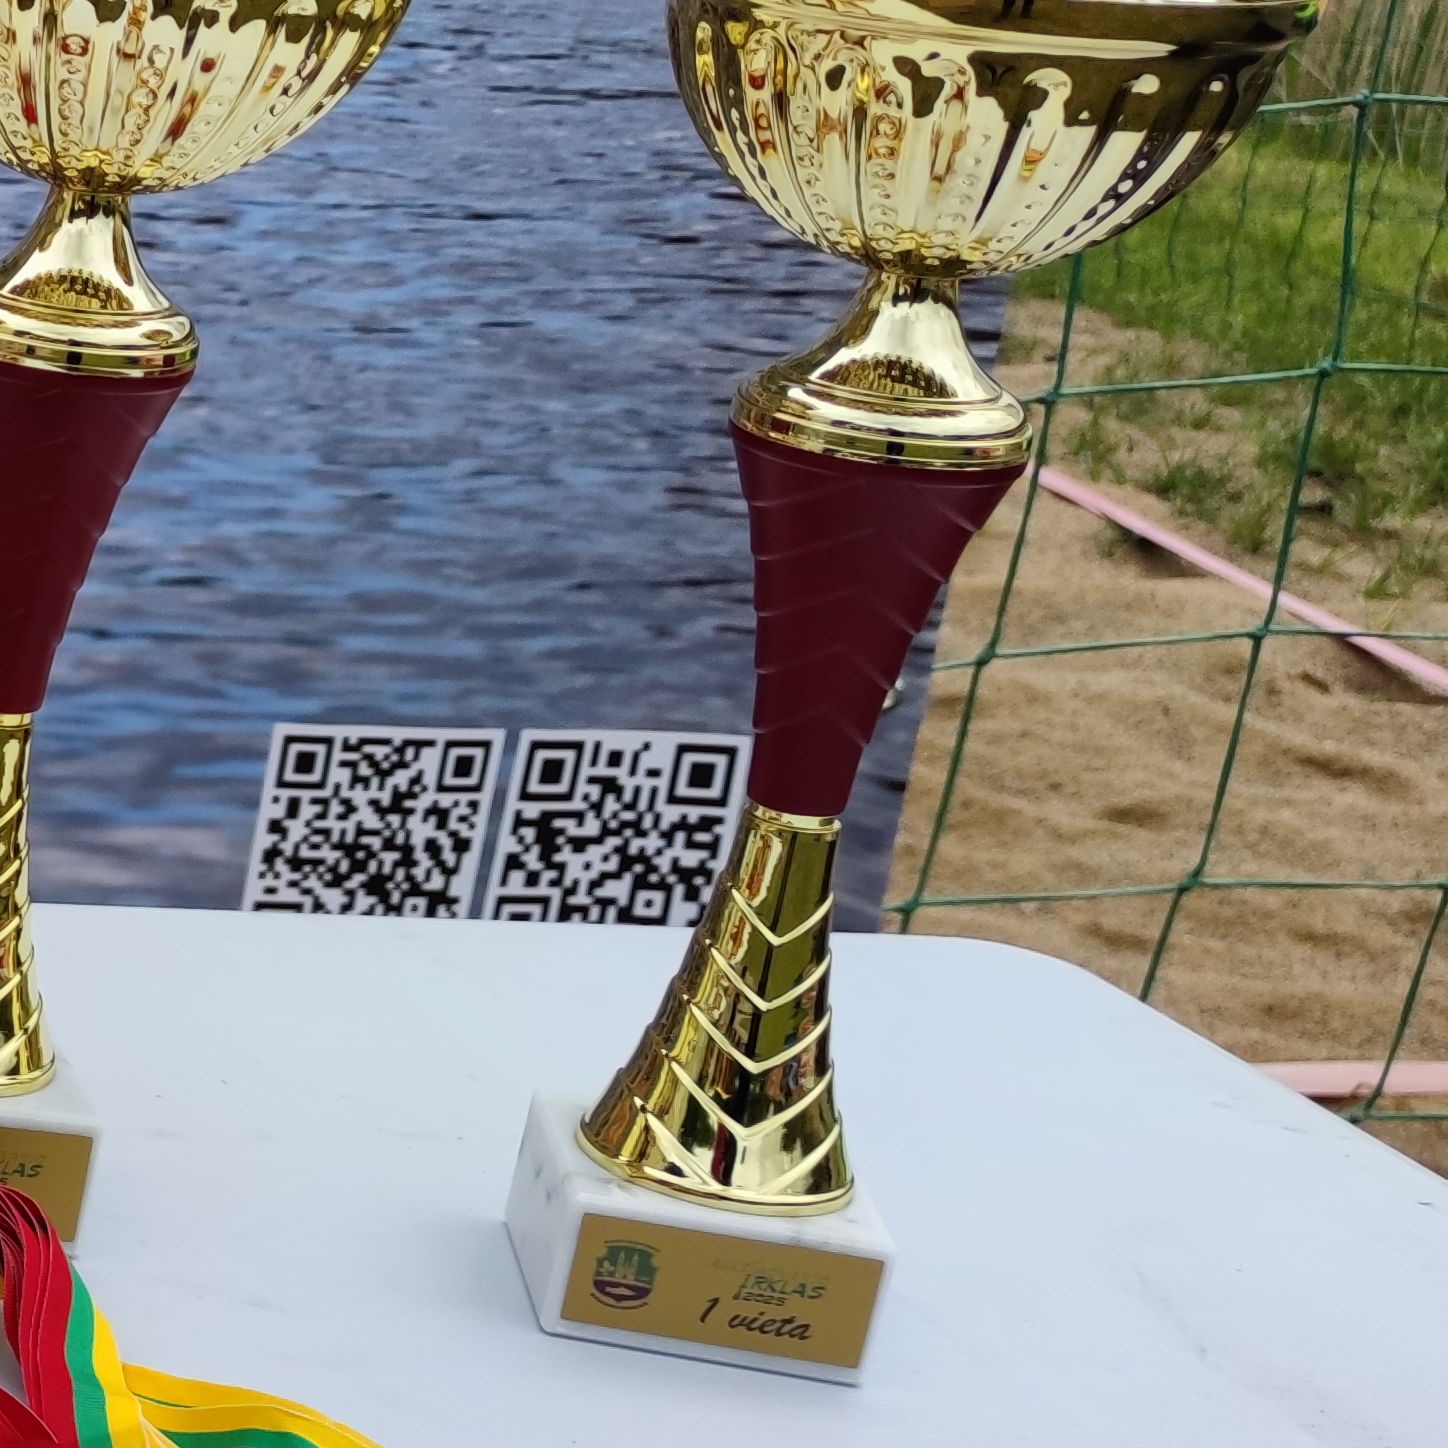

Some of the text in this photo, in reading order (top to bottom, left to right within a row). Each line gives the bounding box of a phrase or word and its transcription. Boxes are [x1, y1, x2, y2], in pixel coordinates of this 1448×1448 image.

[732, 1273, 827, 1301] IRKLAS
[742, 1292, 788, 1307] 2025
[699, 1297, 812, 1340] 1 vieta
